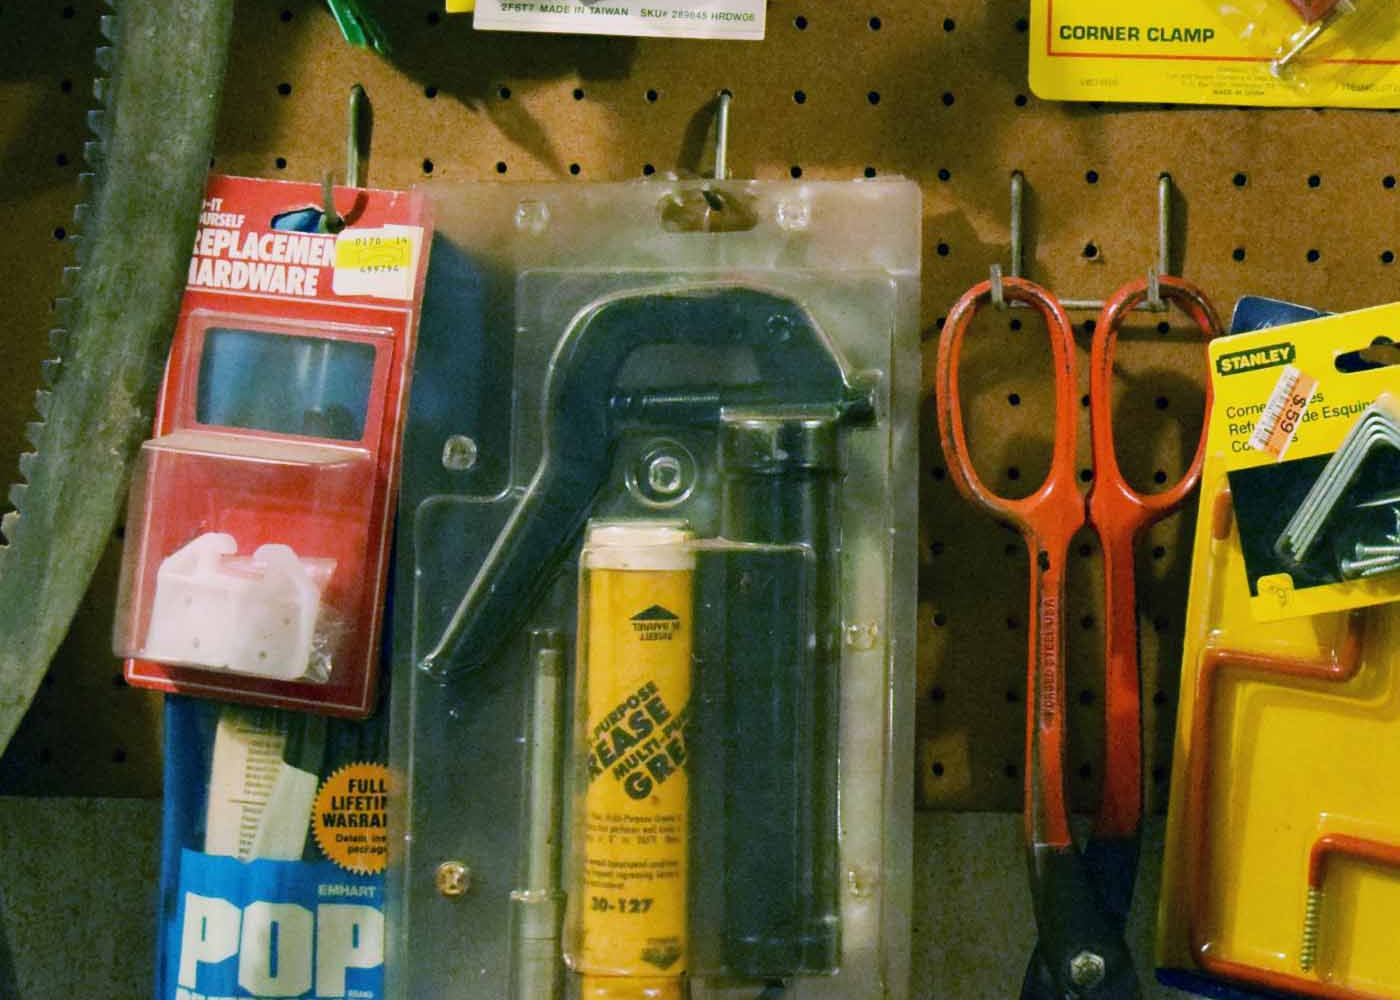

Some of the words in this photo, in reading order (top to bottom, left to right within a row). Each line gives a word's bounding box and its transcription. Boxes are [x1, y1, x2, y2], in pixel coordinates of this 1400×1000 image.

[540, 4, 570, 14] MADE
[589, 6, 629, 17] TAIWAN
[1058, 25, 1141, 42] CORNER
[1146, 27, 1215, 44] CLAMP
[1220, 347, 1291, 372] STANLEY
[1226, 404, 1265, 419] Corne
[347, 778, 387, 793] FULL
[317, 884, 377, 898] EMHART
[178, 891, 384, 998] POP
